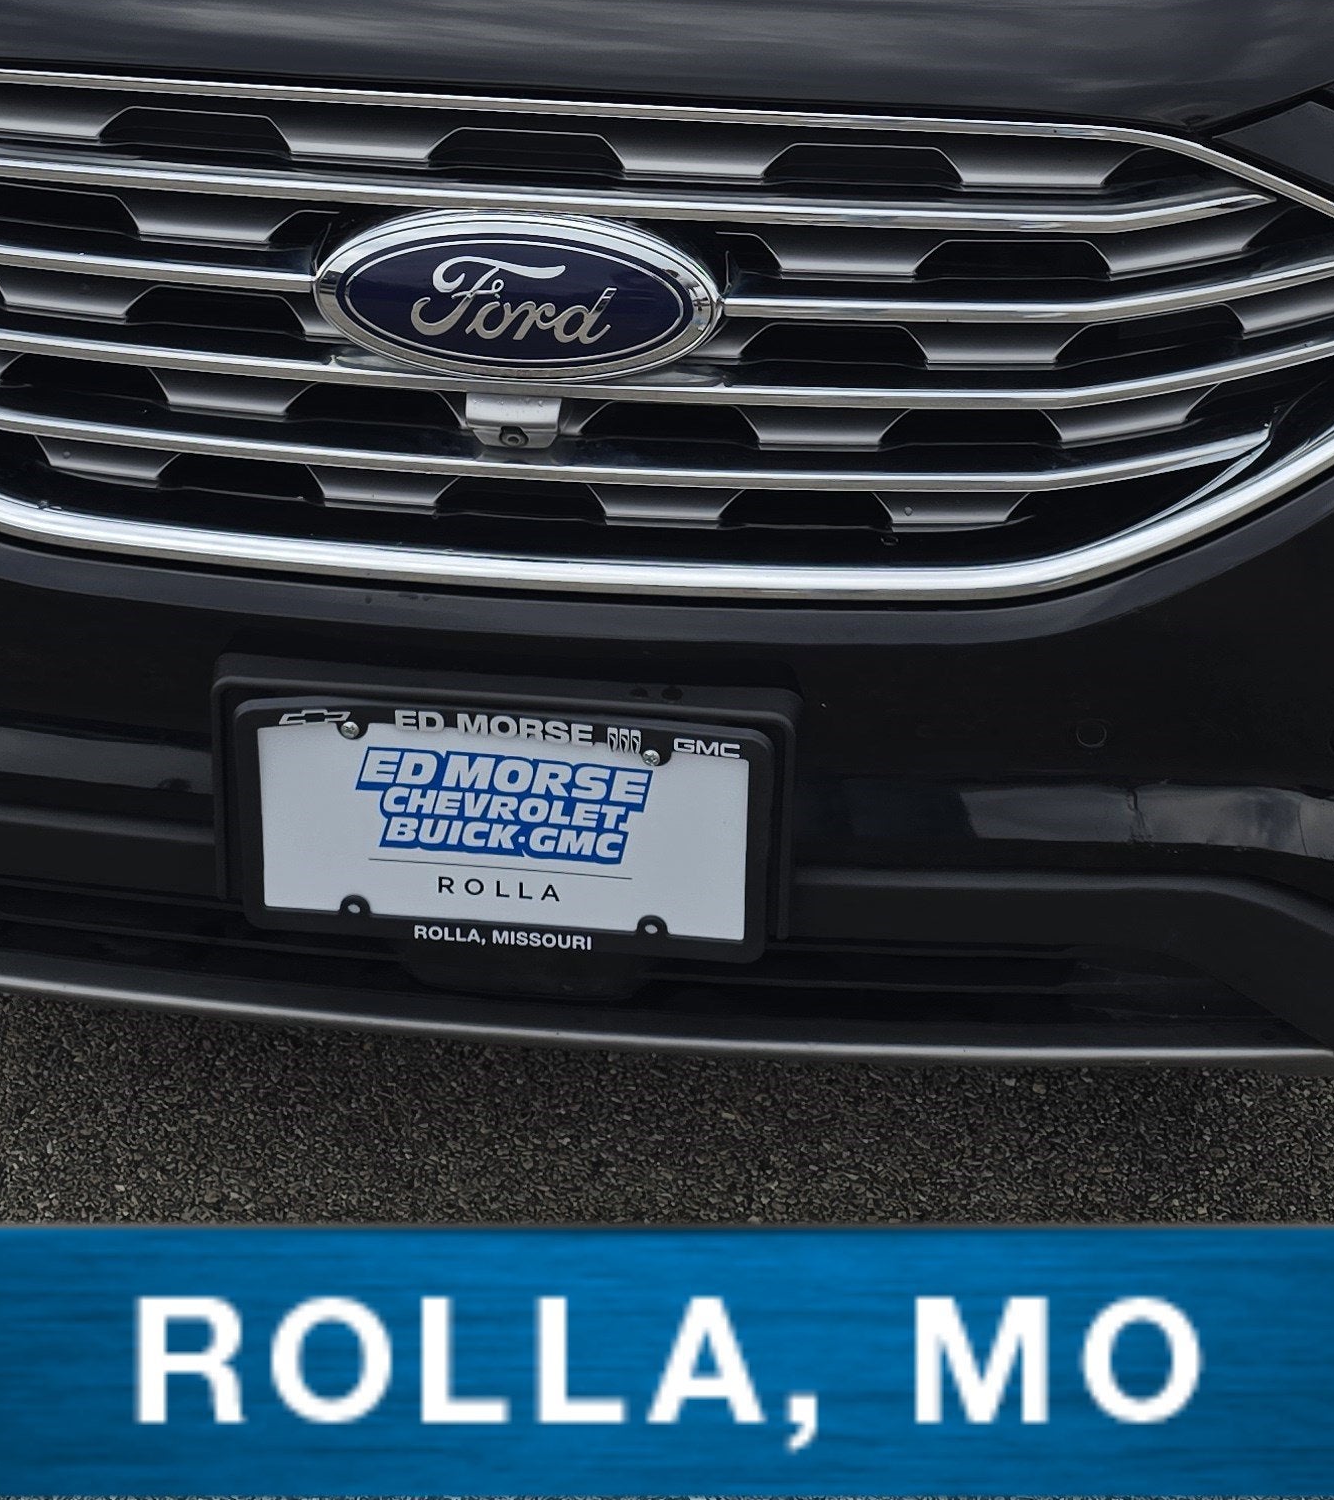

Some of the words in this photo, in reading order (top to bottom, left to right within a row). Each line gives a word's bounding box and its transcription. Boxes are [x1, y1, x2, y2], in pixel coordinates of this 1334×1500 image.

[410, 254, 618, 346] Ford
[394, 709, 445, 734] ED
[456, 713, 594, 747] MORSE
[673, 737, 741, 759] GMC
[360, 749, 438, 787] ED
[441, 751, 650, 804] MORSE
[437, 876, 561, 902] ROLLA
[413, 924, 487, 946] ROLLA,
[491, 929, 593, 951] MISSOURI
